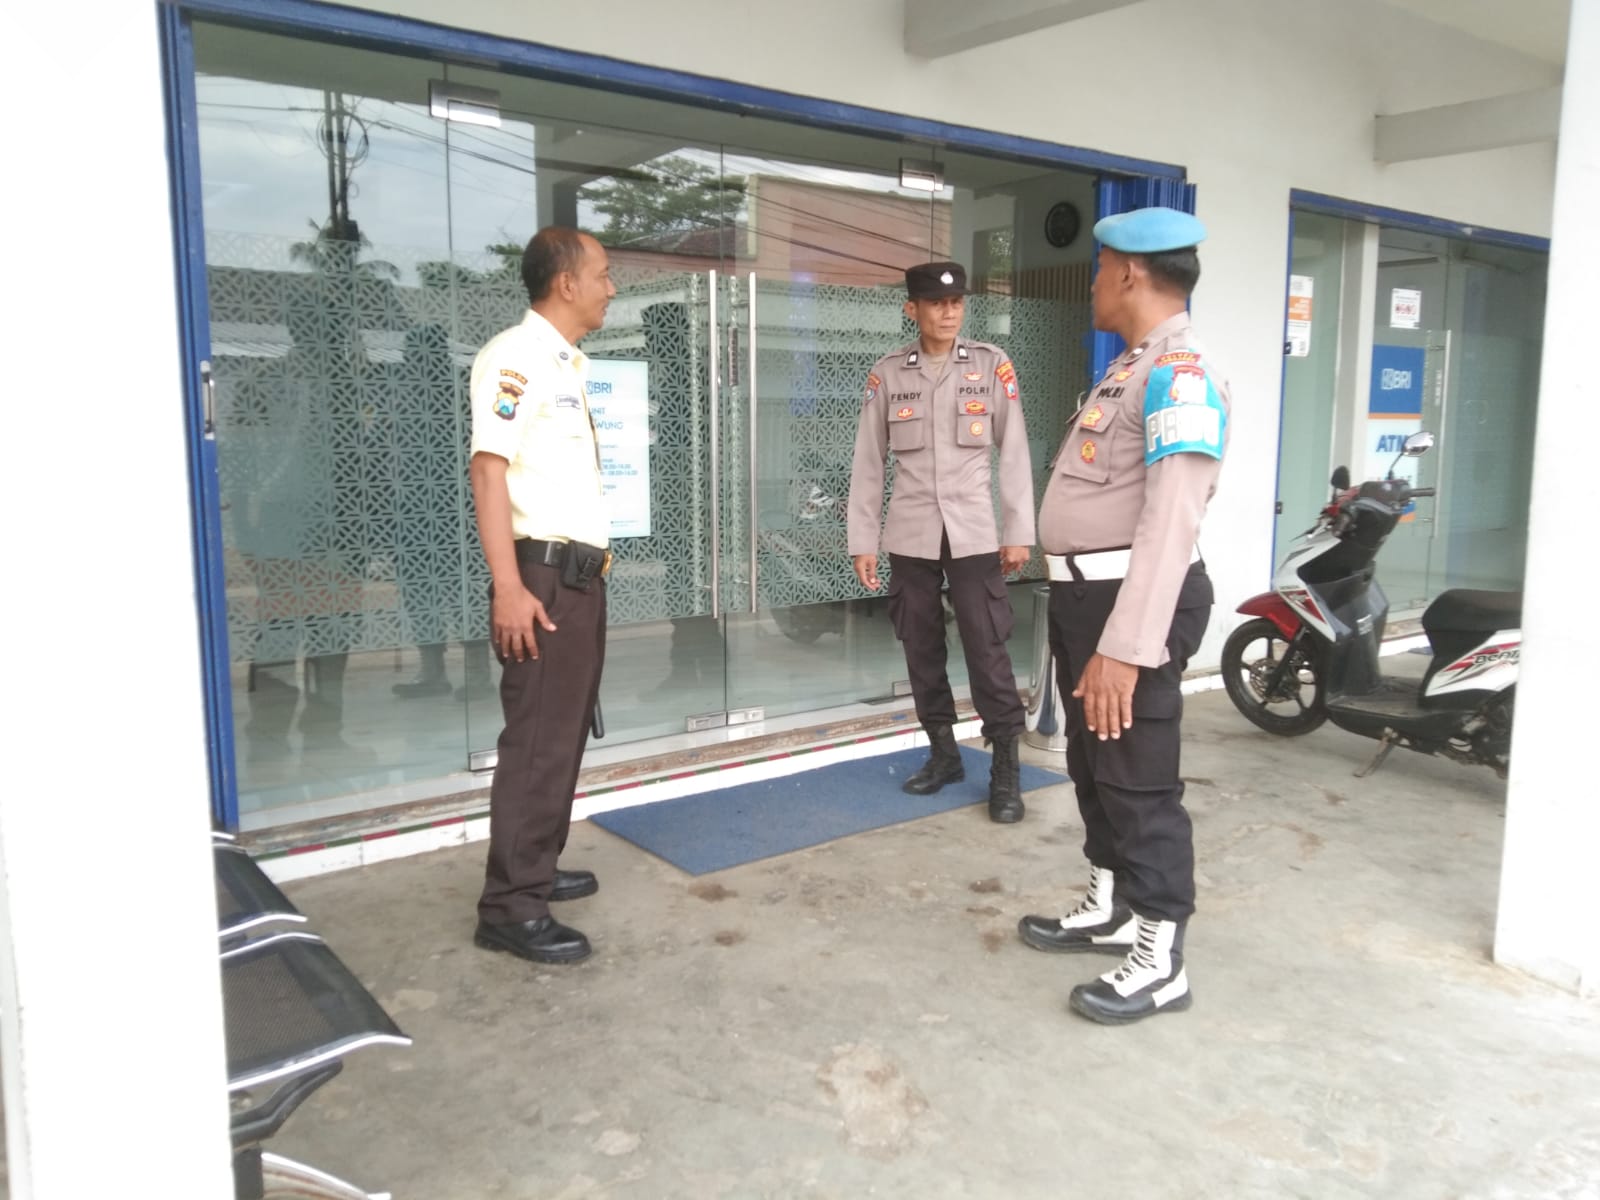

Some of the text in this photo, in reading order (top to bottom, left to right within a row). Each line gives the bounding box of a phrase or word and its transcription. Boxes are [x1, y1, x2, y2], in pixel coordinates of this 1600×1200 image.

[1394, 370, 1412, 389] BRI
[593, 382, 612, 394] BRI
[959, 386, 989, 395] POLRI
[891, 391, 922, 401] FENDY
[593, 418, 624, 431] WUNG
